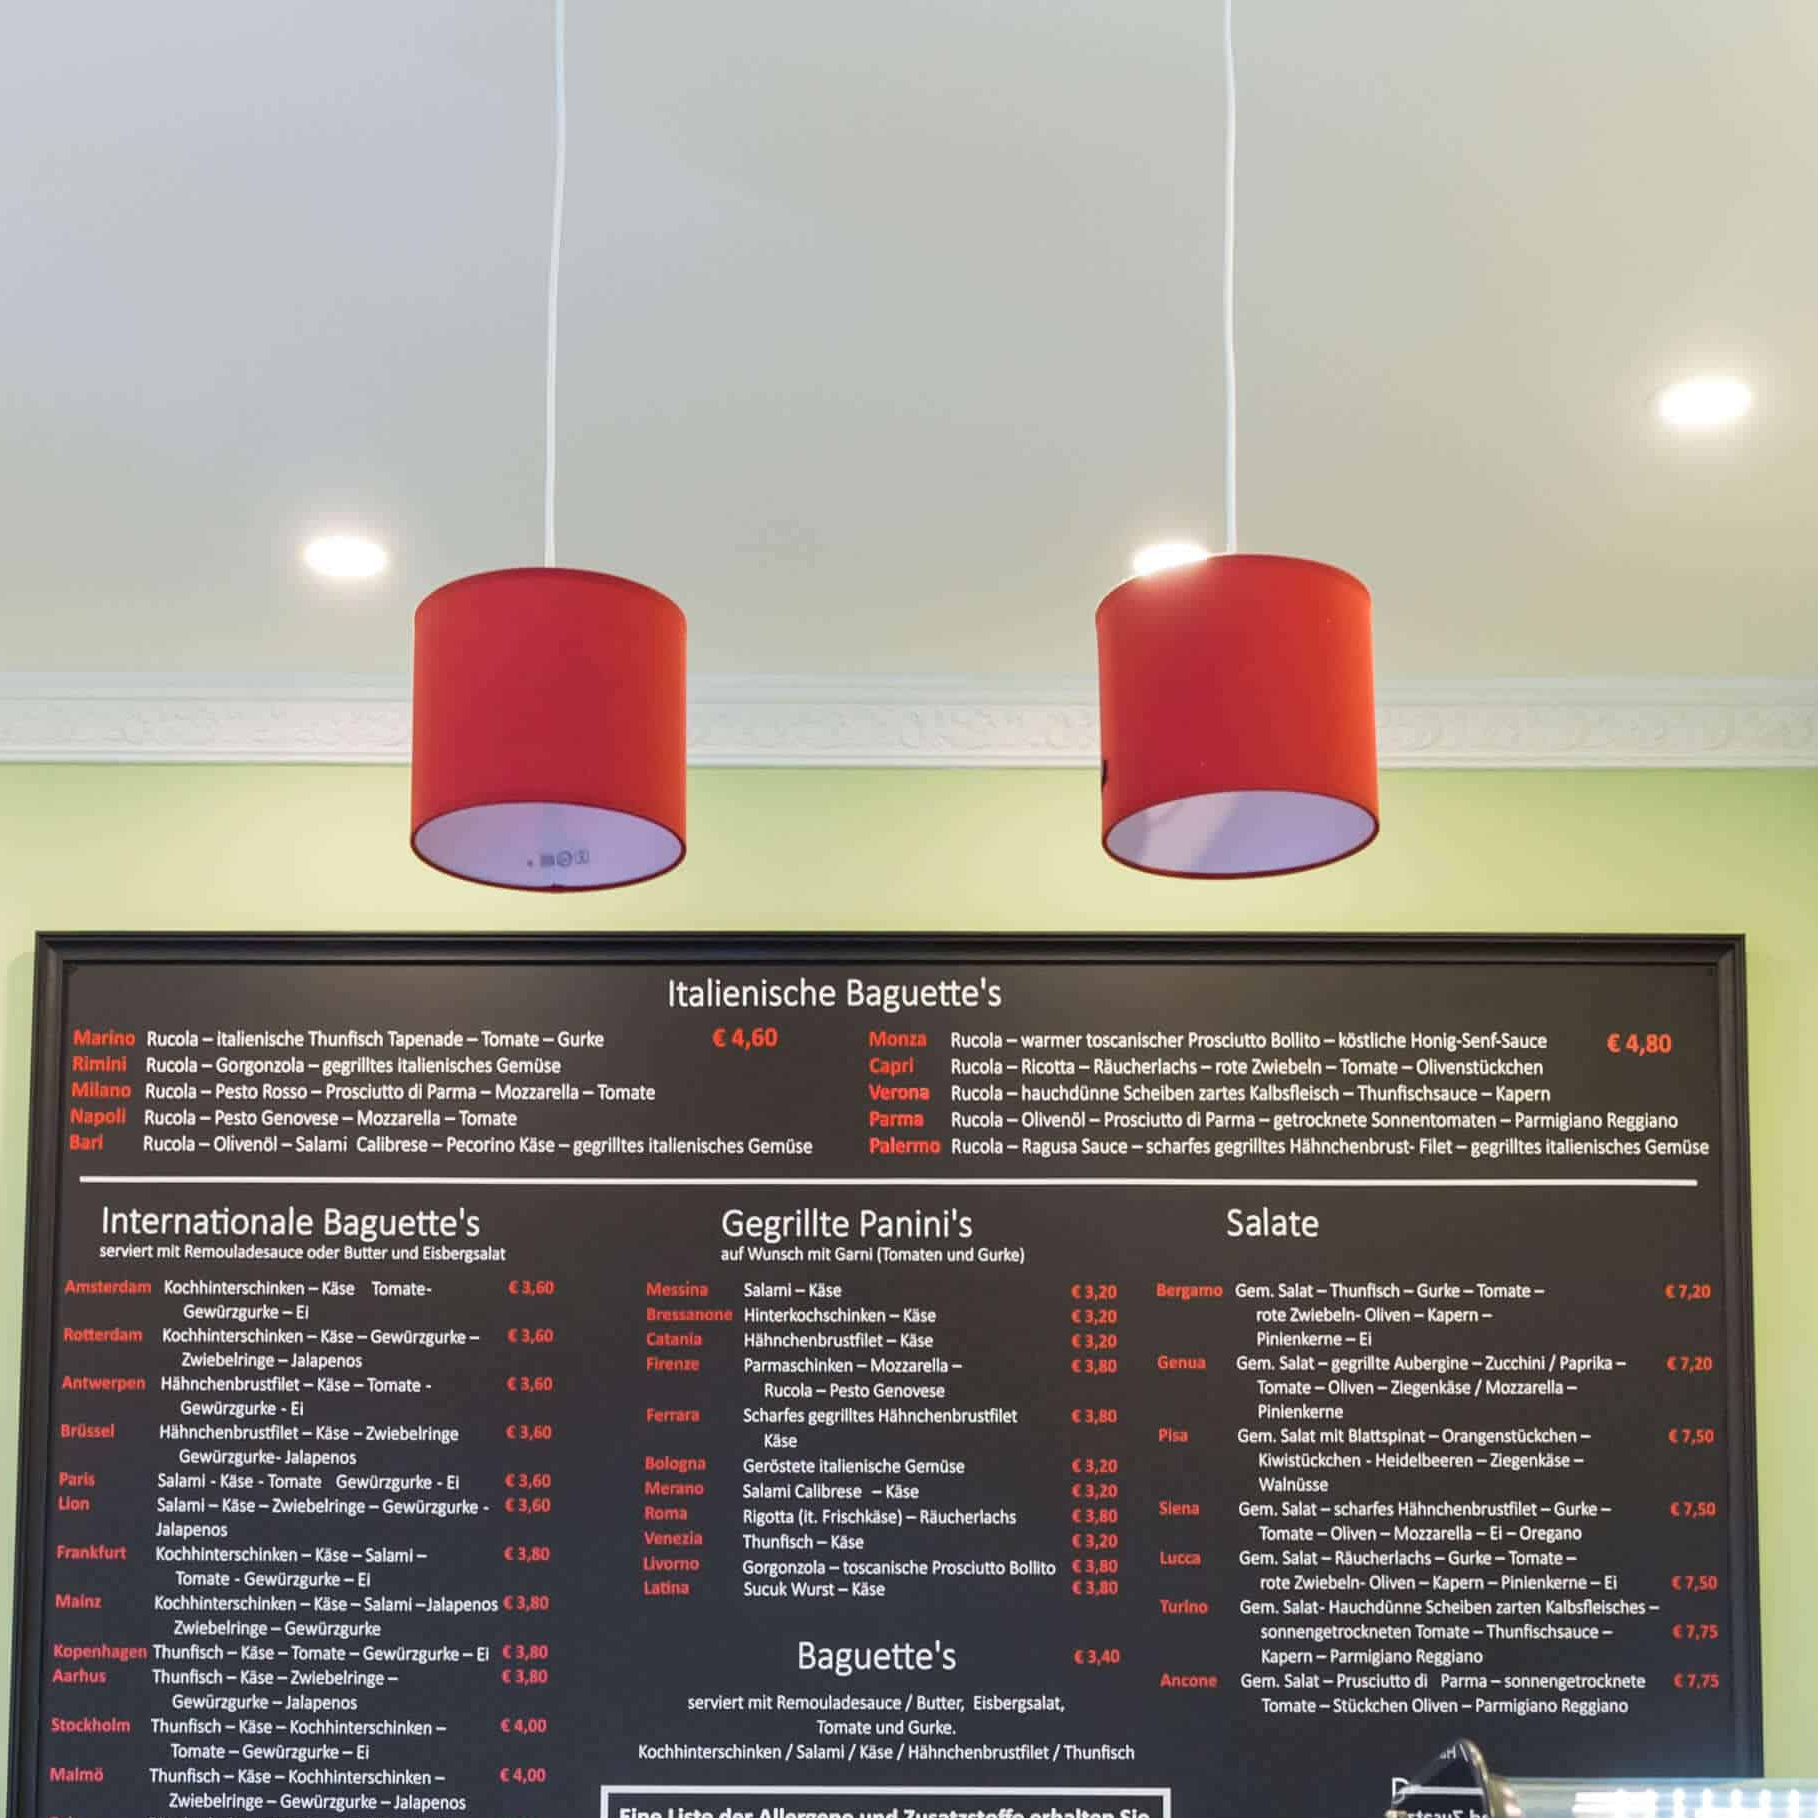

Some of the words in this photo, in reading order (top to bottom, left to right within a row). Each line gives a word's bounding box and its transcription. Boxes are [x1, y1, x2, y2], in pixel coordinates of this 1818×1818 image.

[669, 977, 836, 1008] Italienische
[847, 976, 1002, 1014] Baguette's
[73, 1029, 136, 1046] Marino
[868, 1030, 928, 1047] Monza
[72, 1055, 127, 1072] Rimini
[868, 1056, 914, 1078] Capri
[71, 1081, 132, 1098] Milano
[869, 1136, 941, 1154] Palermo
[102, 1205, 314, 1236] Internationale
[324, 1207, 480, 1242] Baguette's
[722, 1207, 850, 1244] Gegrillte
[860, 1207, 973, 1238] Panini's
[1226, 1206, 1320, 1238] Salate
[99, 1243, 154, 1258] serviert
[156, 1244, 181, 1258] mit
[184, 1243, 304, 1260] Remouladesauce
[306, 1244, 341, 1260] oder
[343, 1245, 389, 1260] Butter
[391, 1245, 419, 1260] und
[422, 1245, 506, 1263] Eisbergsalat
[720, 1245, 745, 1261] auf
[747, 1245, 804, 1262] Wunsch
[807, 1247, 832, 1262] mit
[834, 1246, 873, 1262] Garni
[876, 1246, 943, 1264] (Tomaten
[946, 1247, 975, 1262] und
[977, 1247, 1025, 1265] Gurke)
[64, 1279, 152, 1294] Amsterdam
[646, 1280, 709, 1297] Messina
[1156, 1282, 1224, 1301] Bergamo
[63, 1327, 143, 1342] Rotterdam
[1157, 1354, 1207, 1370] Genua
[743, 1407, 805, 1423] Scharfes
[807, 1407, 875, 1426] gegrilltes
[878, 1407, 1018, 1424] Hähnchenbrustfilet
[60, 1423, 115, 1439] Brüssel
[643, 1530, 703, 1546] Venezia
[1159, 1551, 1202, 1566] Lucca
[798, 1639, 957, 1677] Baguette's
[1160, 1673, 1218, 1688] Ancone
[51, 1717, 131, 1733] Stockholm
[49, 1767, 104, 1782] Malmö
